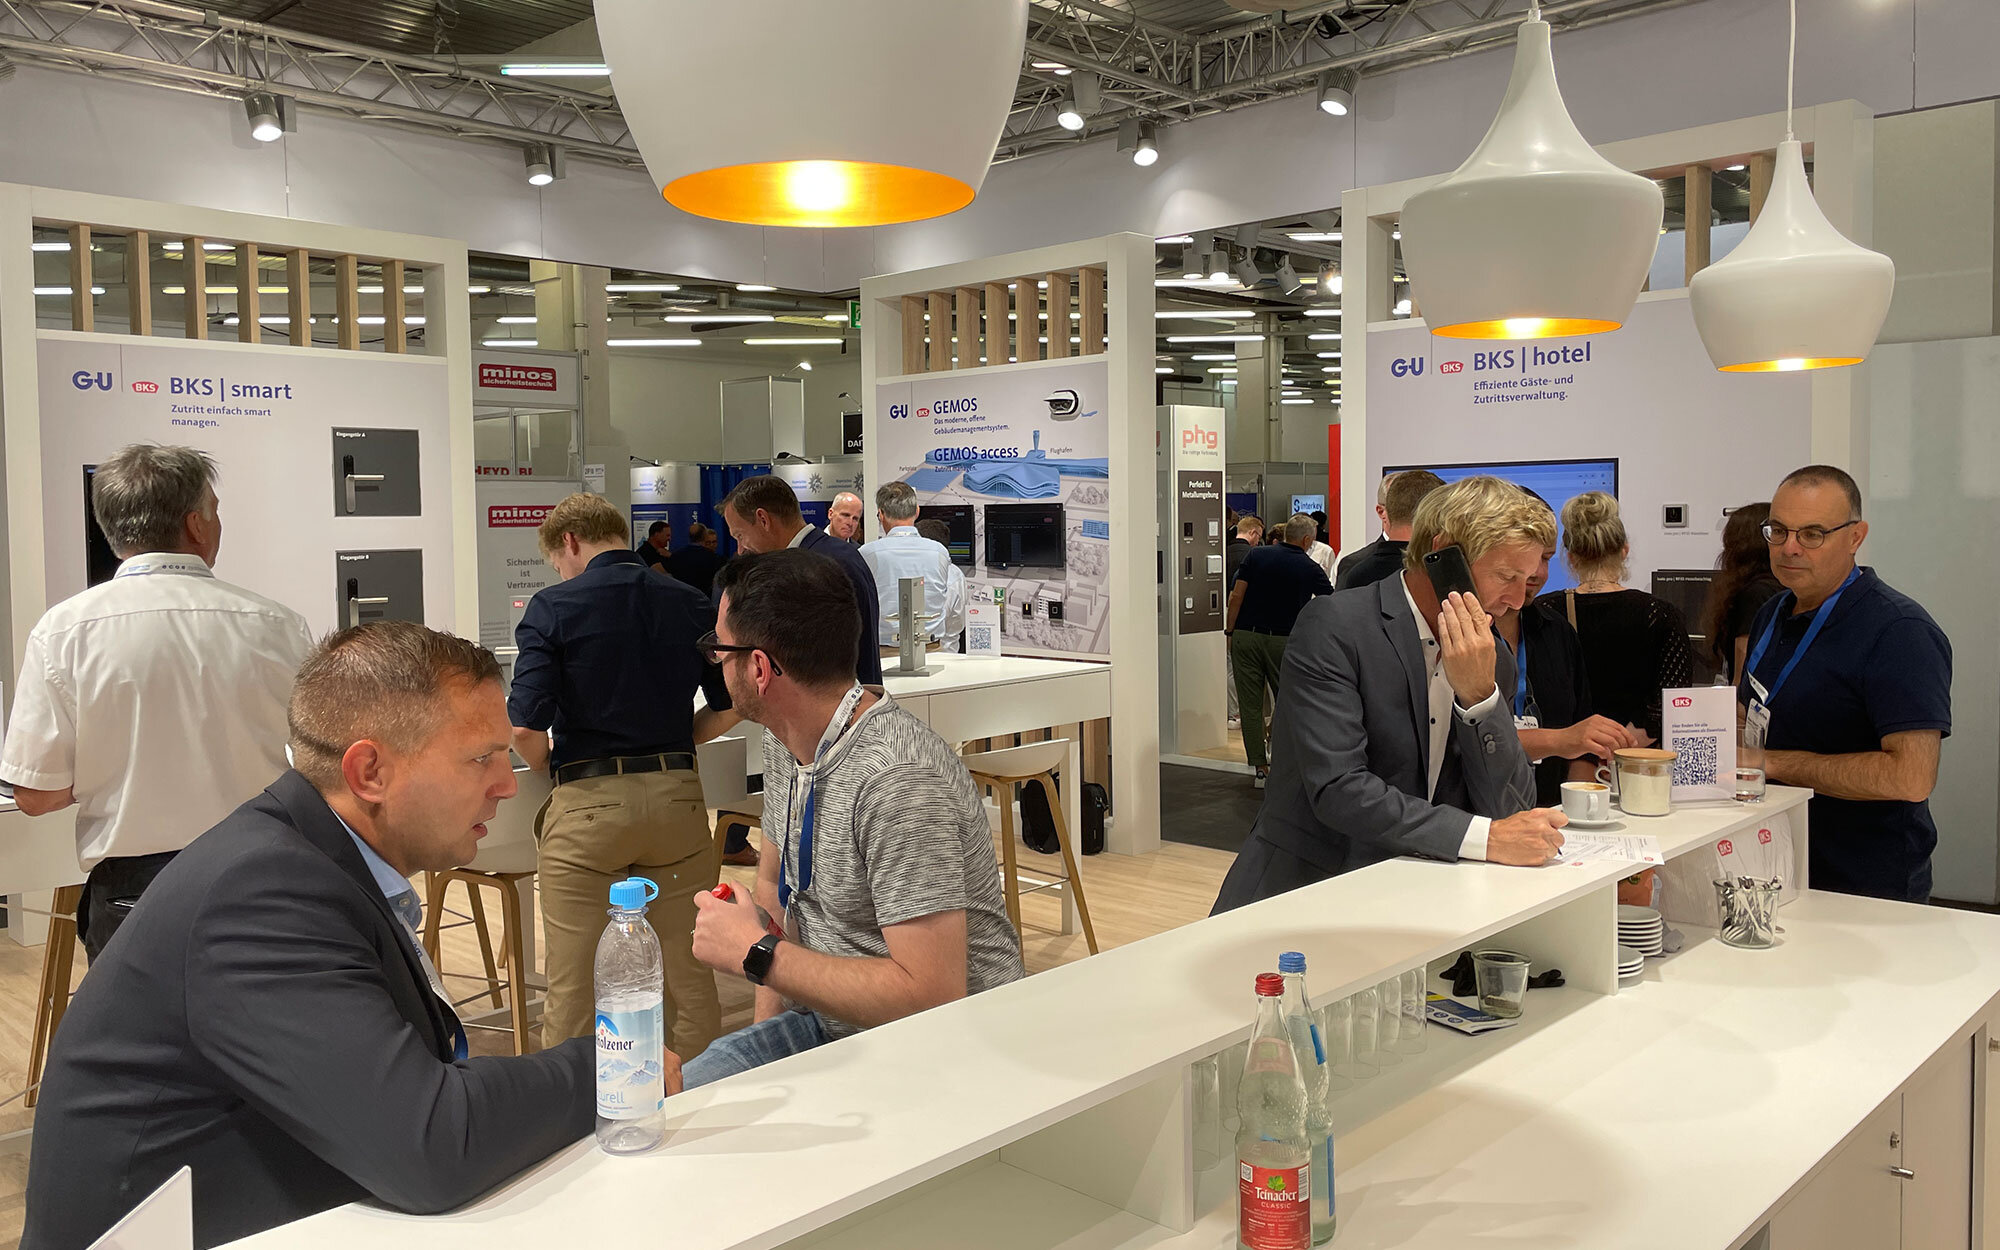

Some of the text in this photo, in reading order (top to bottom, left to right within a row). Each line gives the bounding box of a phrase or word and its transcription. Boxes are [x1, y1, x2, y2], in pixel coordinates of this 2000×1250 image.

[1474, 341, 1591, 371] BKS hotel
[482, 367, 553, 380] minos
[1441, 363, 1461, 374] BKS
[135, 383, 156, 393] BKS
[170, 377, 292, 399] BKS smart
[483, 378, 553, 388] sicherheitstechnik
[1474, 374, 1574, 391] Effiziente Gäste- und
[1474, 390, 1568, 404] Zutrittsverwaltung.
[171, 404, 271, 416] Zutritt einfach smart
[933, 398, 978, 414] GEMOS
[171, 418, 220, 428] managen.
[934, 417, 943, 425] Das
[944, 416, 969, 424] moderne,
[934, 424, 1010, 435] Gebäudemanagementsystem.
[1182, 424, 1218, 449] phg
[934, 446, 1018, 461] GEMOS access
[1050, 446, 1073, 455] Flughafen
[1188, 480, 1213, 488] Perfekt für
[1182, 491, 1219, 500] Metallumgebung
[506, 558, 545, 567] Sicherheit
[507, 581, 546, 589] Vertrauen
[1674, 698, 1690, 707] BKS
[1255, 1187, 1297, 1201] Teinacher
